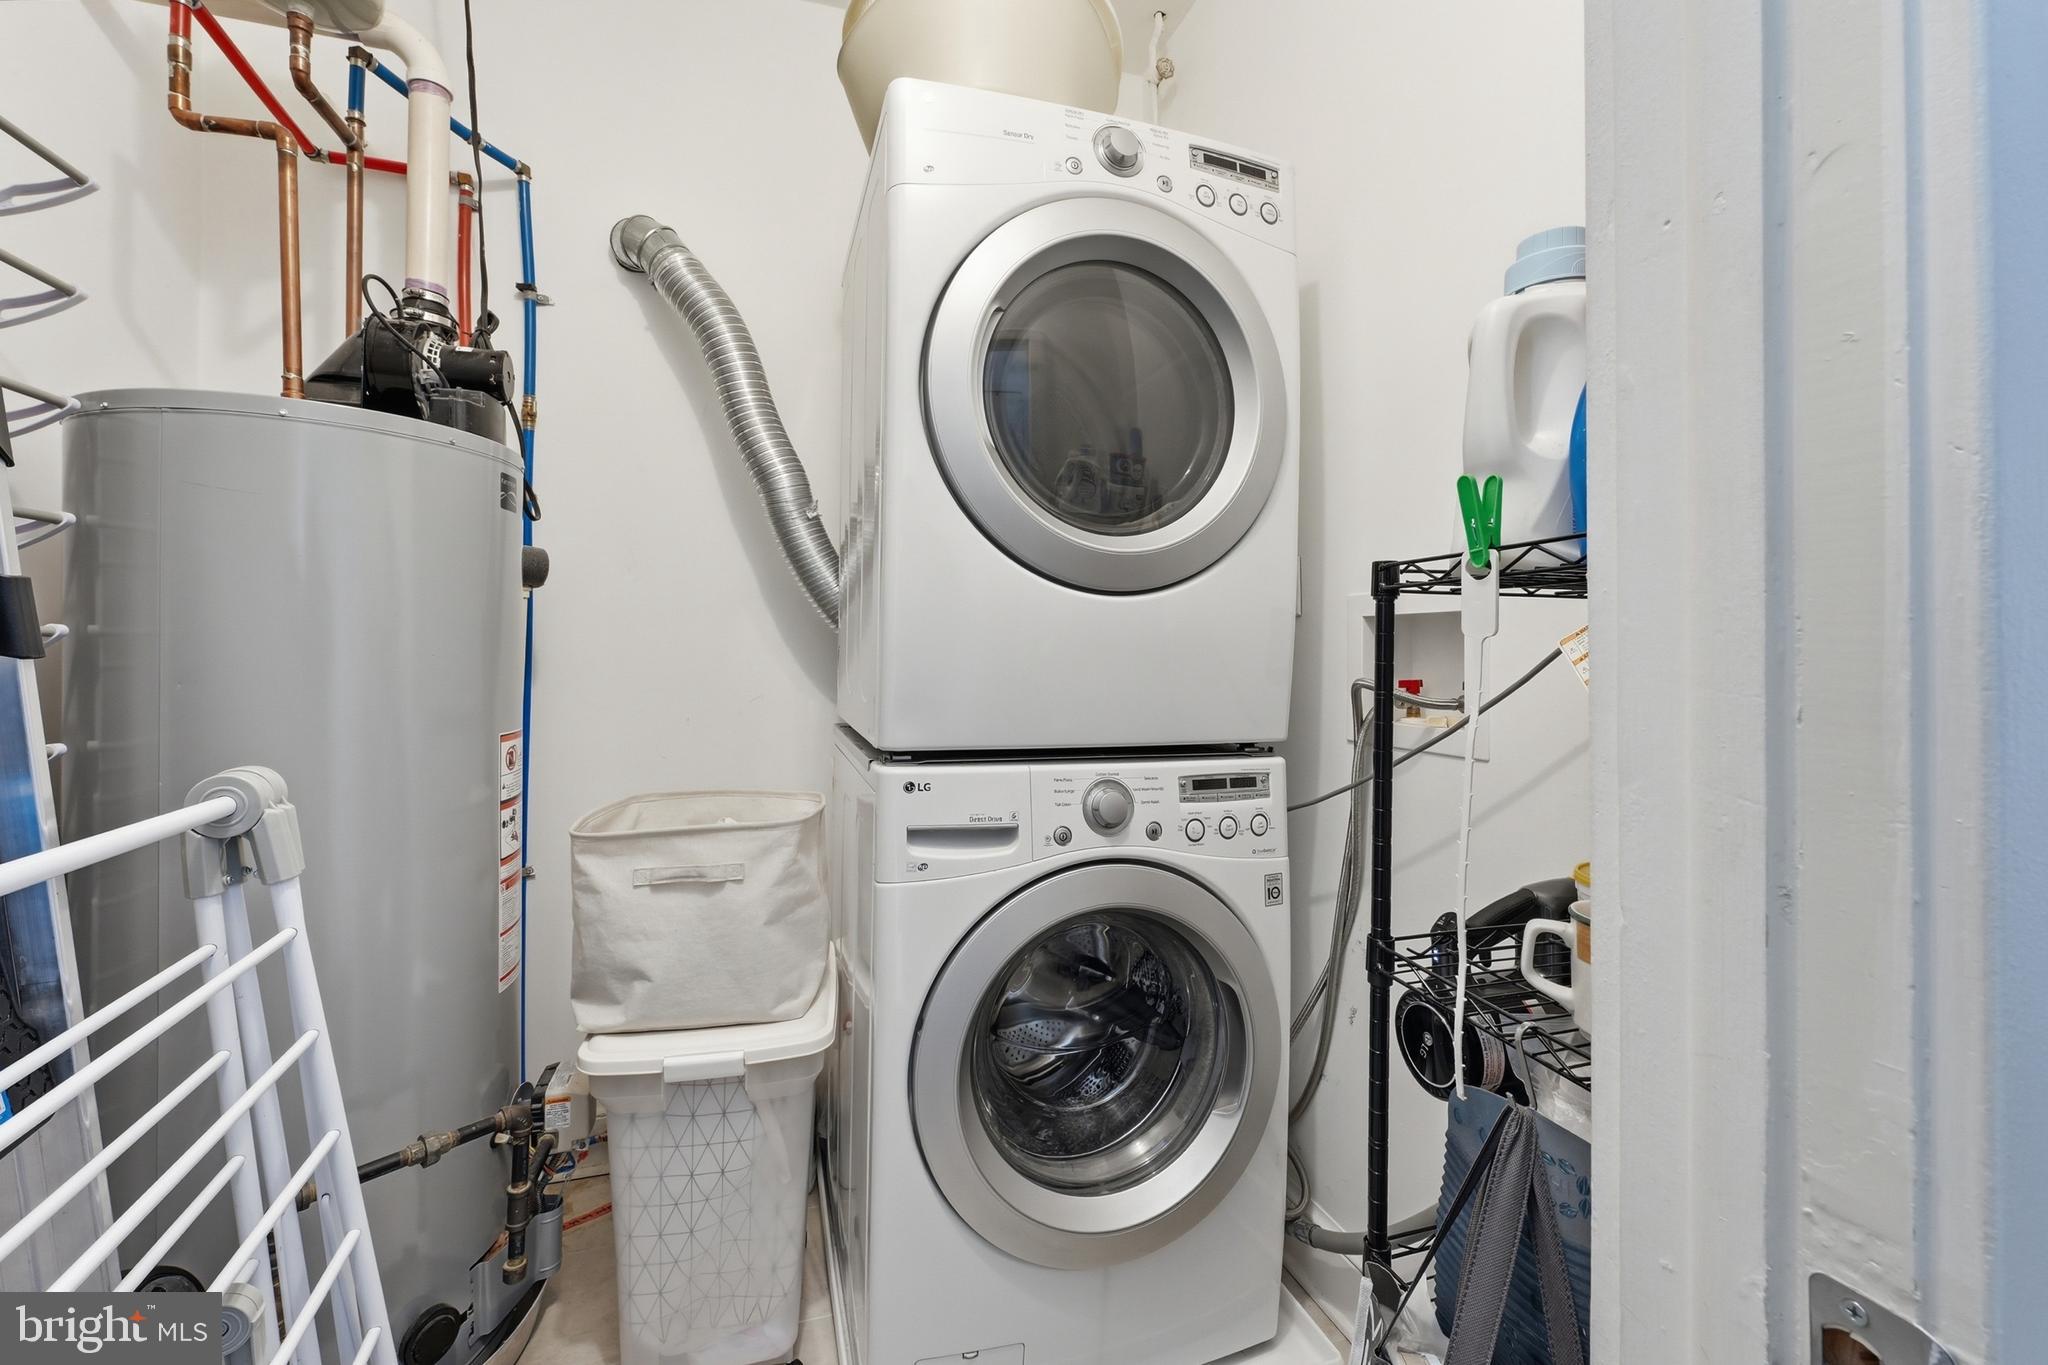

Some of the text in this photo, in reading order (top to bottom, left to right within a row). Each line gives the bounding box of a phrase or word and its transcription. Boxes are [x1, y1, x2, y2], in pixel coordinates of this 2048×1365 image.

[1002, 129, 1035, 142] Sensor Dry
[917, 782, 931, 792] LG
[987, 815, 1003, 823] Drive
[1419, 1043, 1429, 1058] LG
